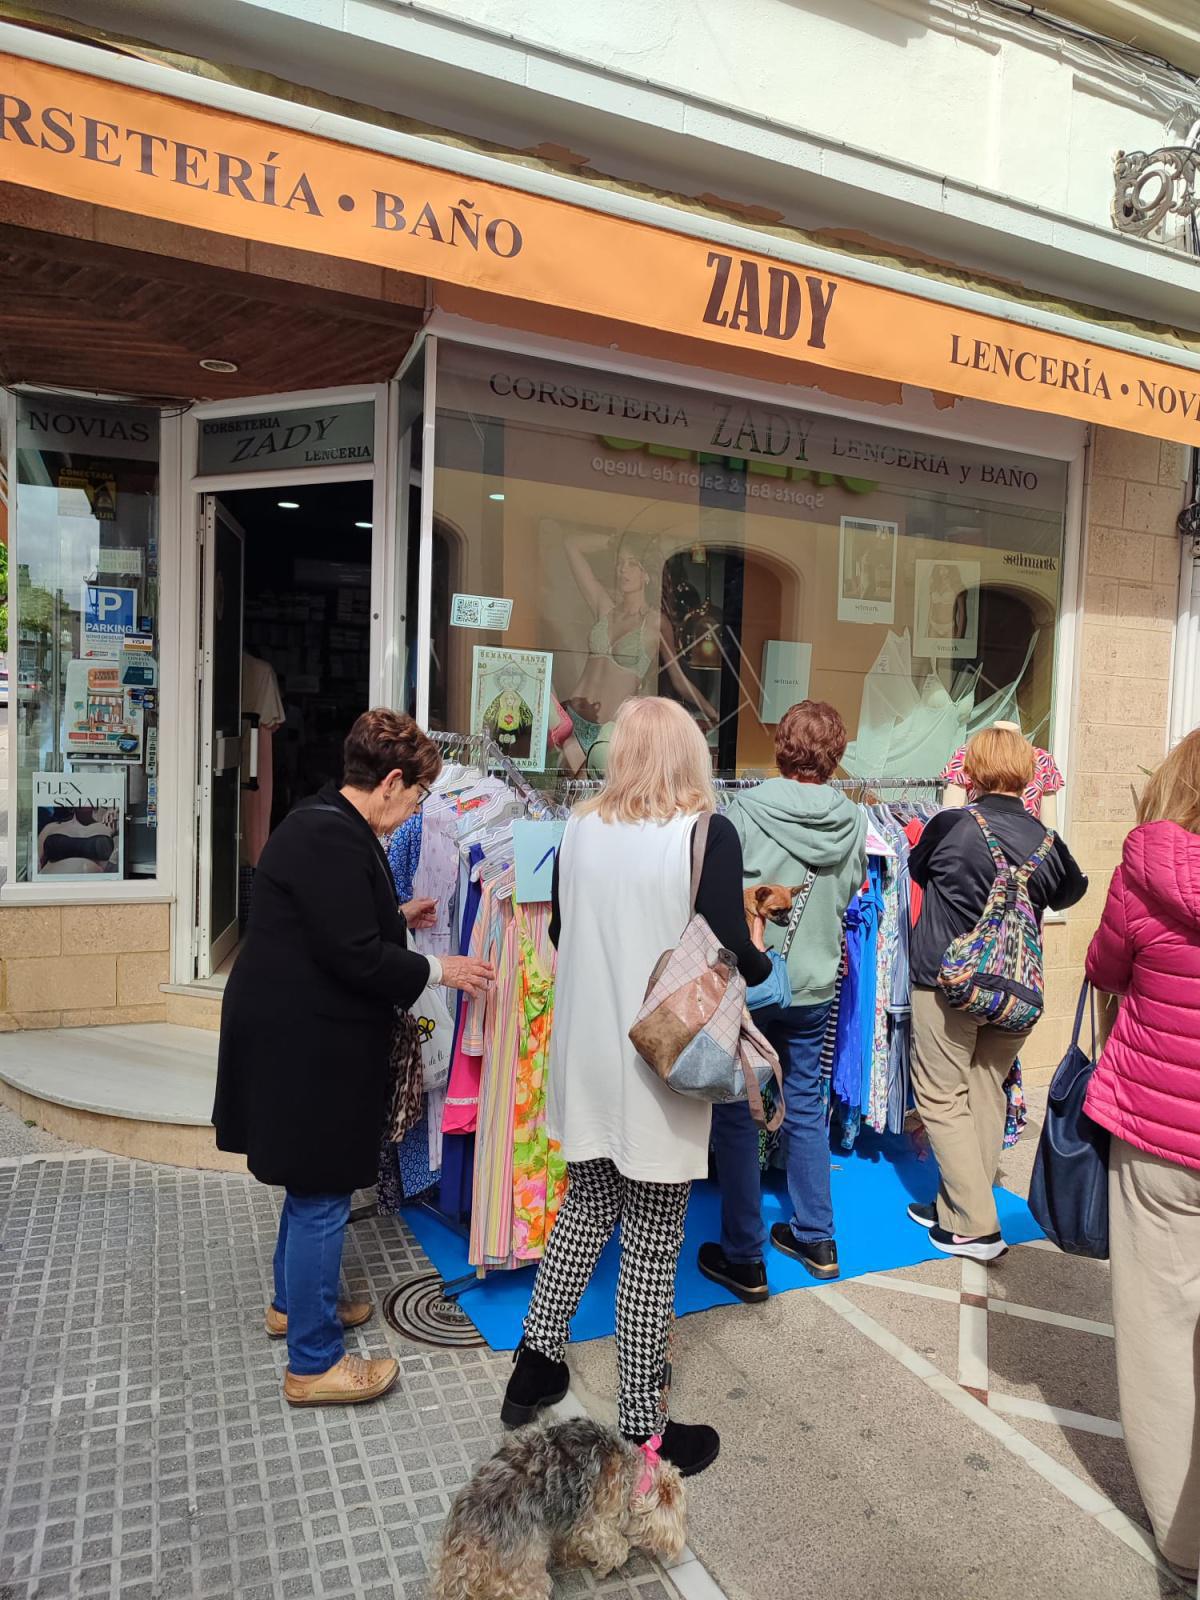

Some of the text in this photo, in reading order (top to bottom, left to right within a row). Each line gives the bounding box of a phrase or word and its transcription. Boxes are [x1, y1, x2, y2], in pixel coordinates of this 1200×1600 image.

[0, 94, 523, 259] RSETERÍA BAÑO
[702, 252, 837, 350] ZADY
[950, 334, 1112, 400] LENCERÍA
[29, 411, 149, 442] NOVIAS
[203, 417, 281, 435] CORSETERIA
[229, 415, 340, 463] ZADY
[489, 372, 689, 427] CORSETERIA
[710, 403, 815, 462] ZADY
[831, 437, 950, 475] LENCERIA
[959, 464, 971, 484] y
[305, 445, 371, 461] LENCERIA
[98, 591, 122, 621] P
[85, 623, 133, 633] PARKING
[37, 781, 82, 795] FLEX
[53, 797, 121, 811] SMART
